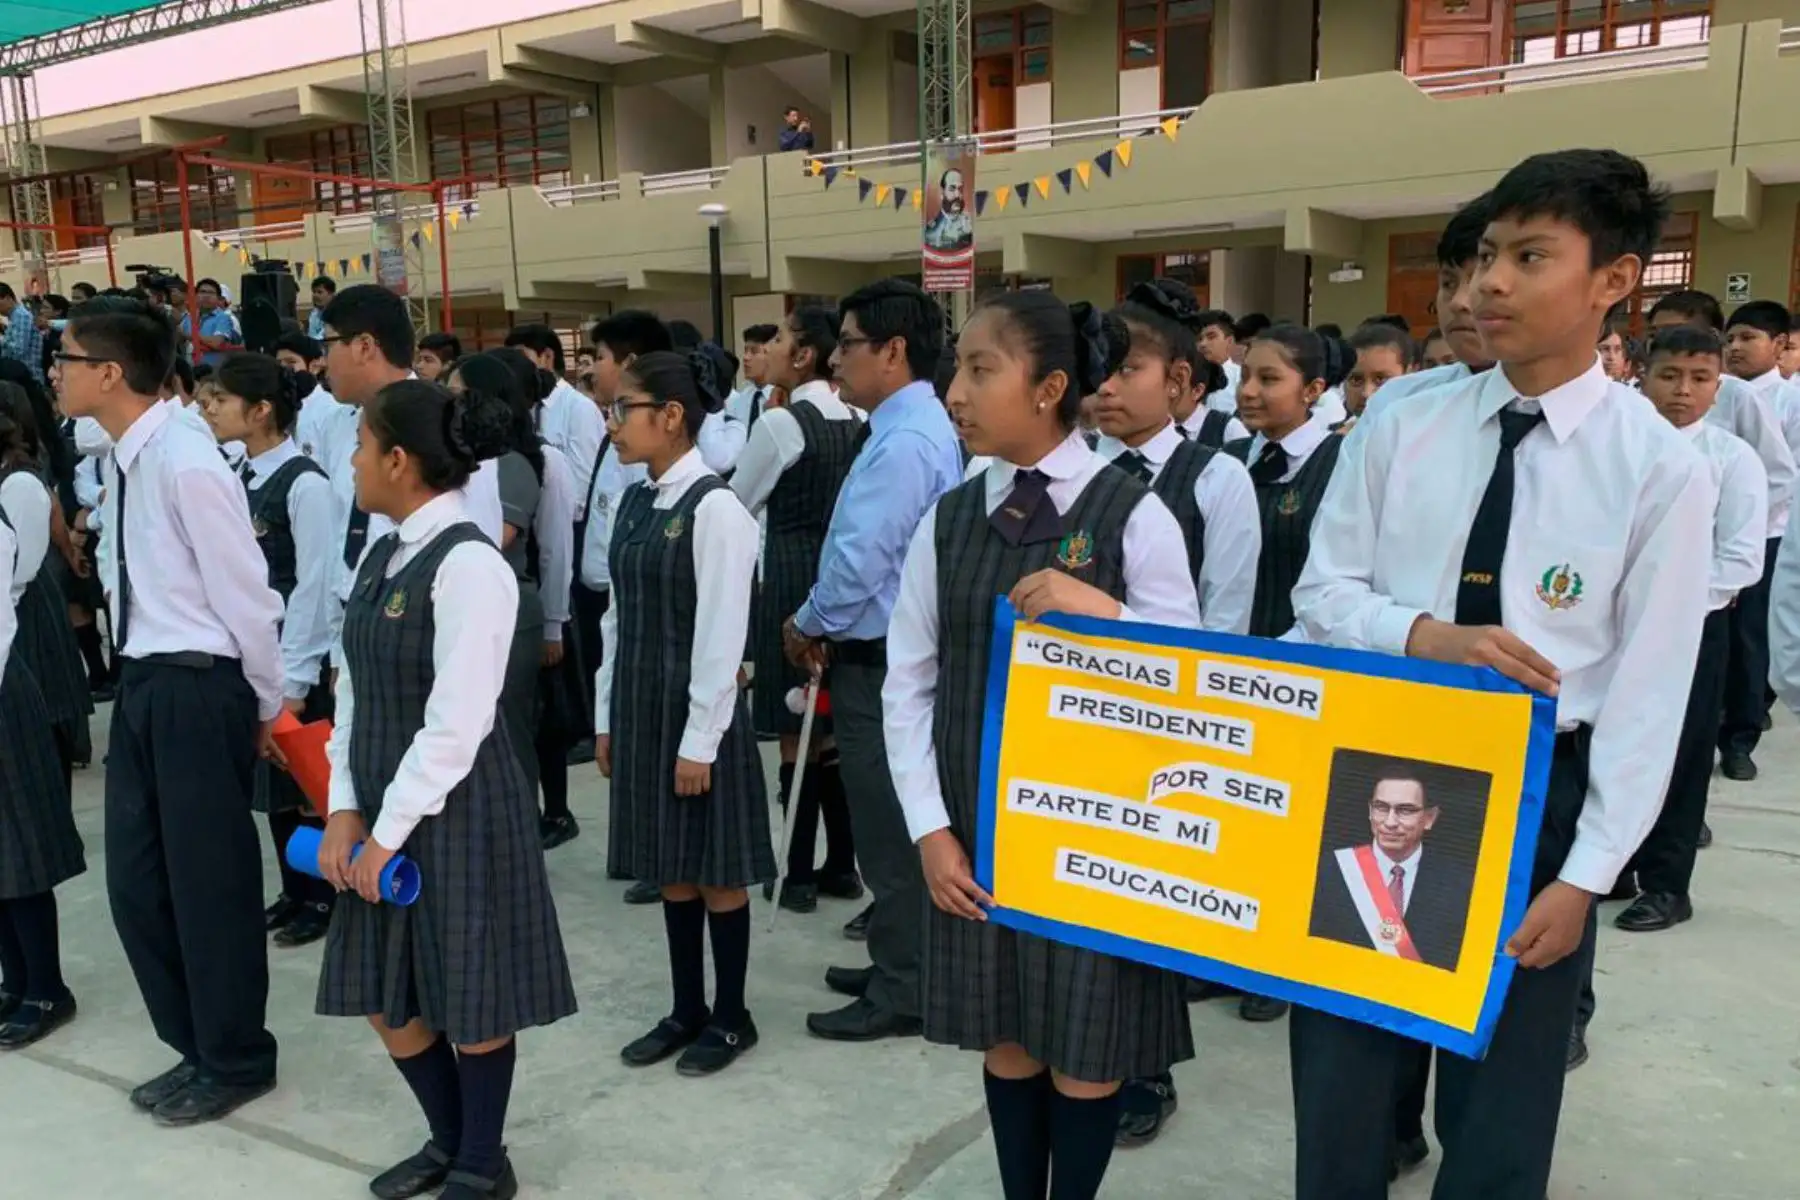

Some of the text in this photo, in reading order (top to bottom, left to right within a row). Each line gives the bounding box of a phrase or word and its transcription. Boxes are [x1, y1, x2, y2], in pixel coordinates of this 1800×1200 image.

[1026, 639, 1319, 712] “GRACIAS SEÑOR
[1059, 694, 1246, 747] PRESIDENTE
[1017, 787, 1211, 846] PARTE DE MÍ
[1151, 769, 1284, 809] POR SER
[1065, 853, 1258, 922] EDUCACIÓN”
